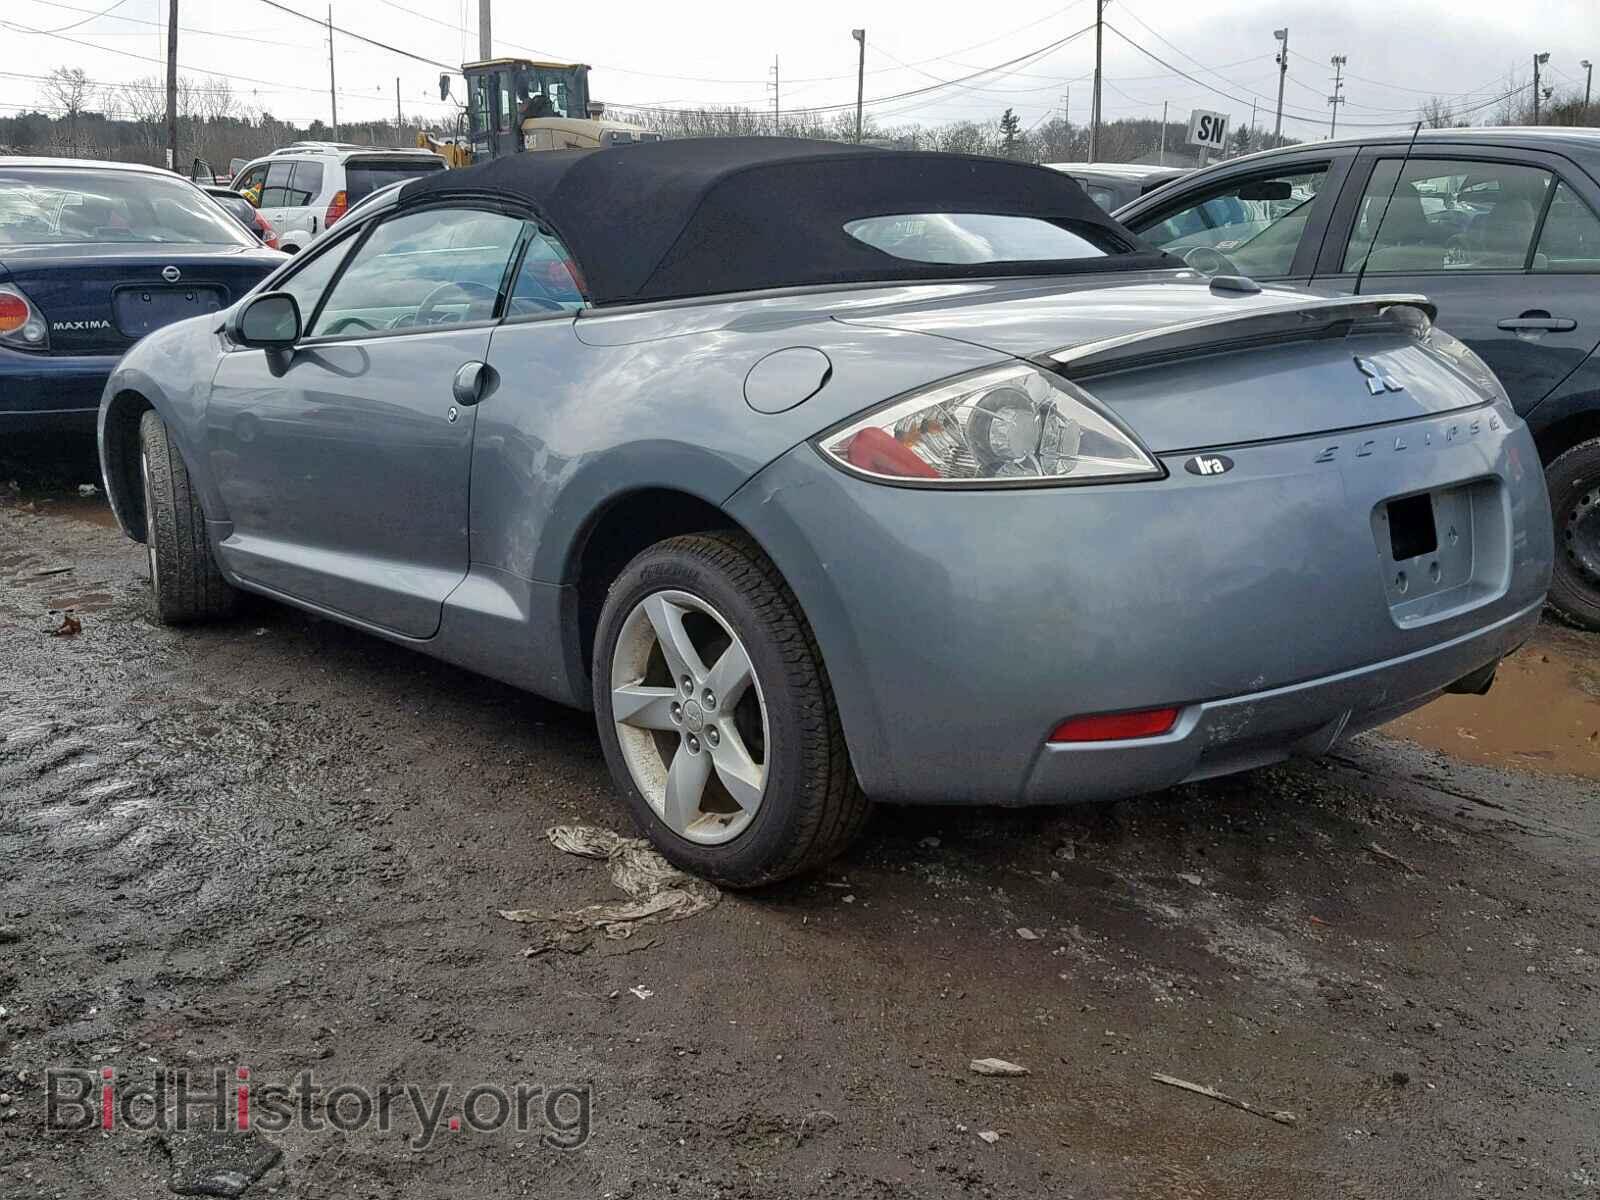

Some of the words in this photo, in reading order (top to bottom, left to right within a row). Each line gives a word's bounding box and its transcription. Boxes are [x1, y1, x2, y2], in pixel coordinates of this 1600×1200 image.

[1198, 115, 1225, 143] SN
[53, 320, 111, 330] MAXIMA
[1314, 415, 1500, 464] ECLIPSE
